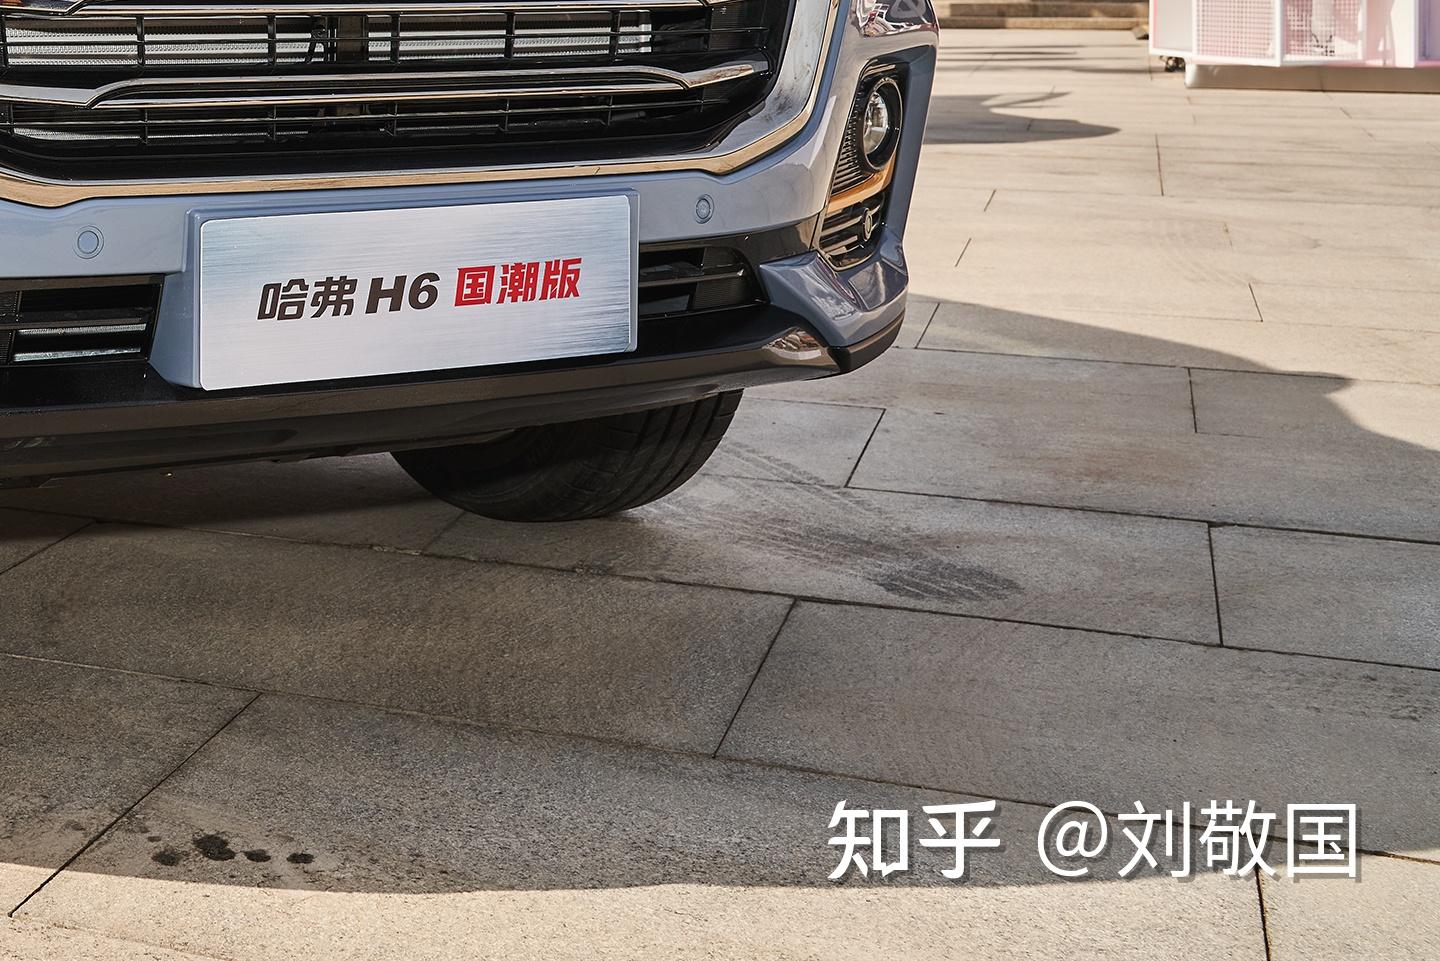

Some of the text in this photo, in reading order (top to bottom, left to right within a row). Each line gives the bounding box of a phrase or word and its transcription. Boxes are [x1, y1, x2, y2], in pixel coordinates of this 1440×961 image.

[257, 257, 582, 321] 哈弗 H6 国潮版
